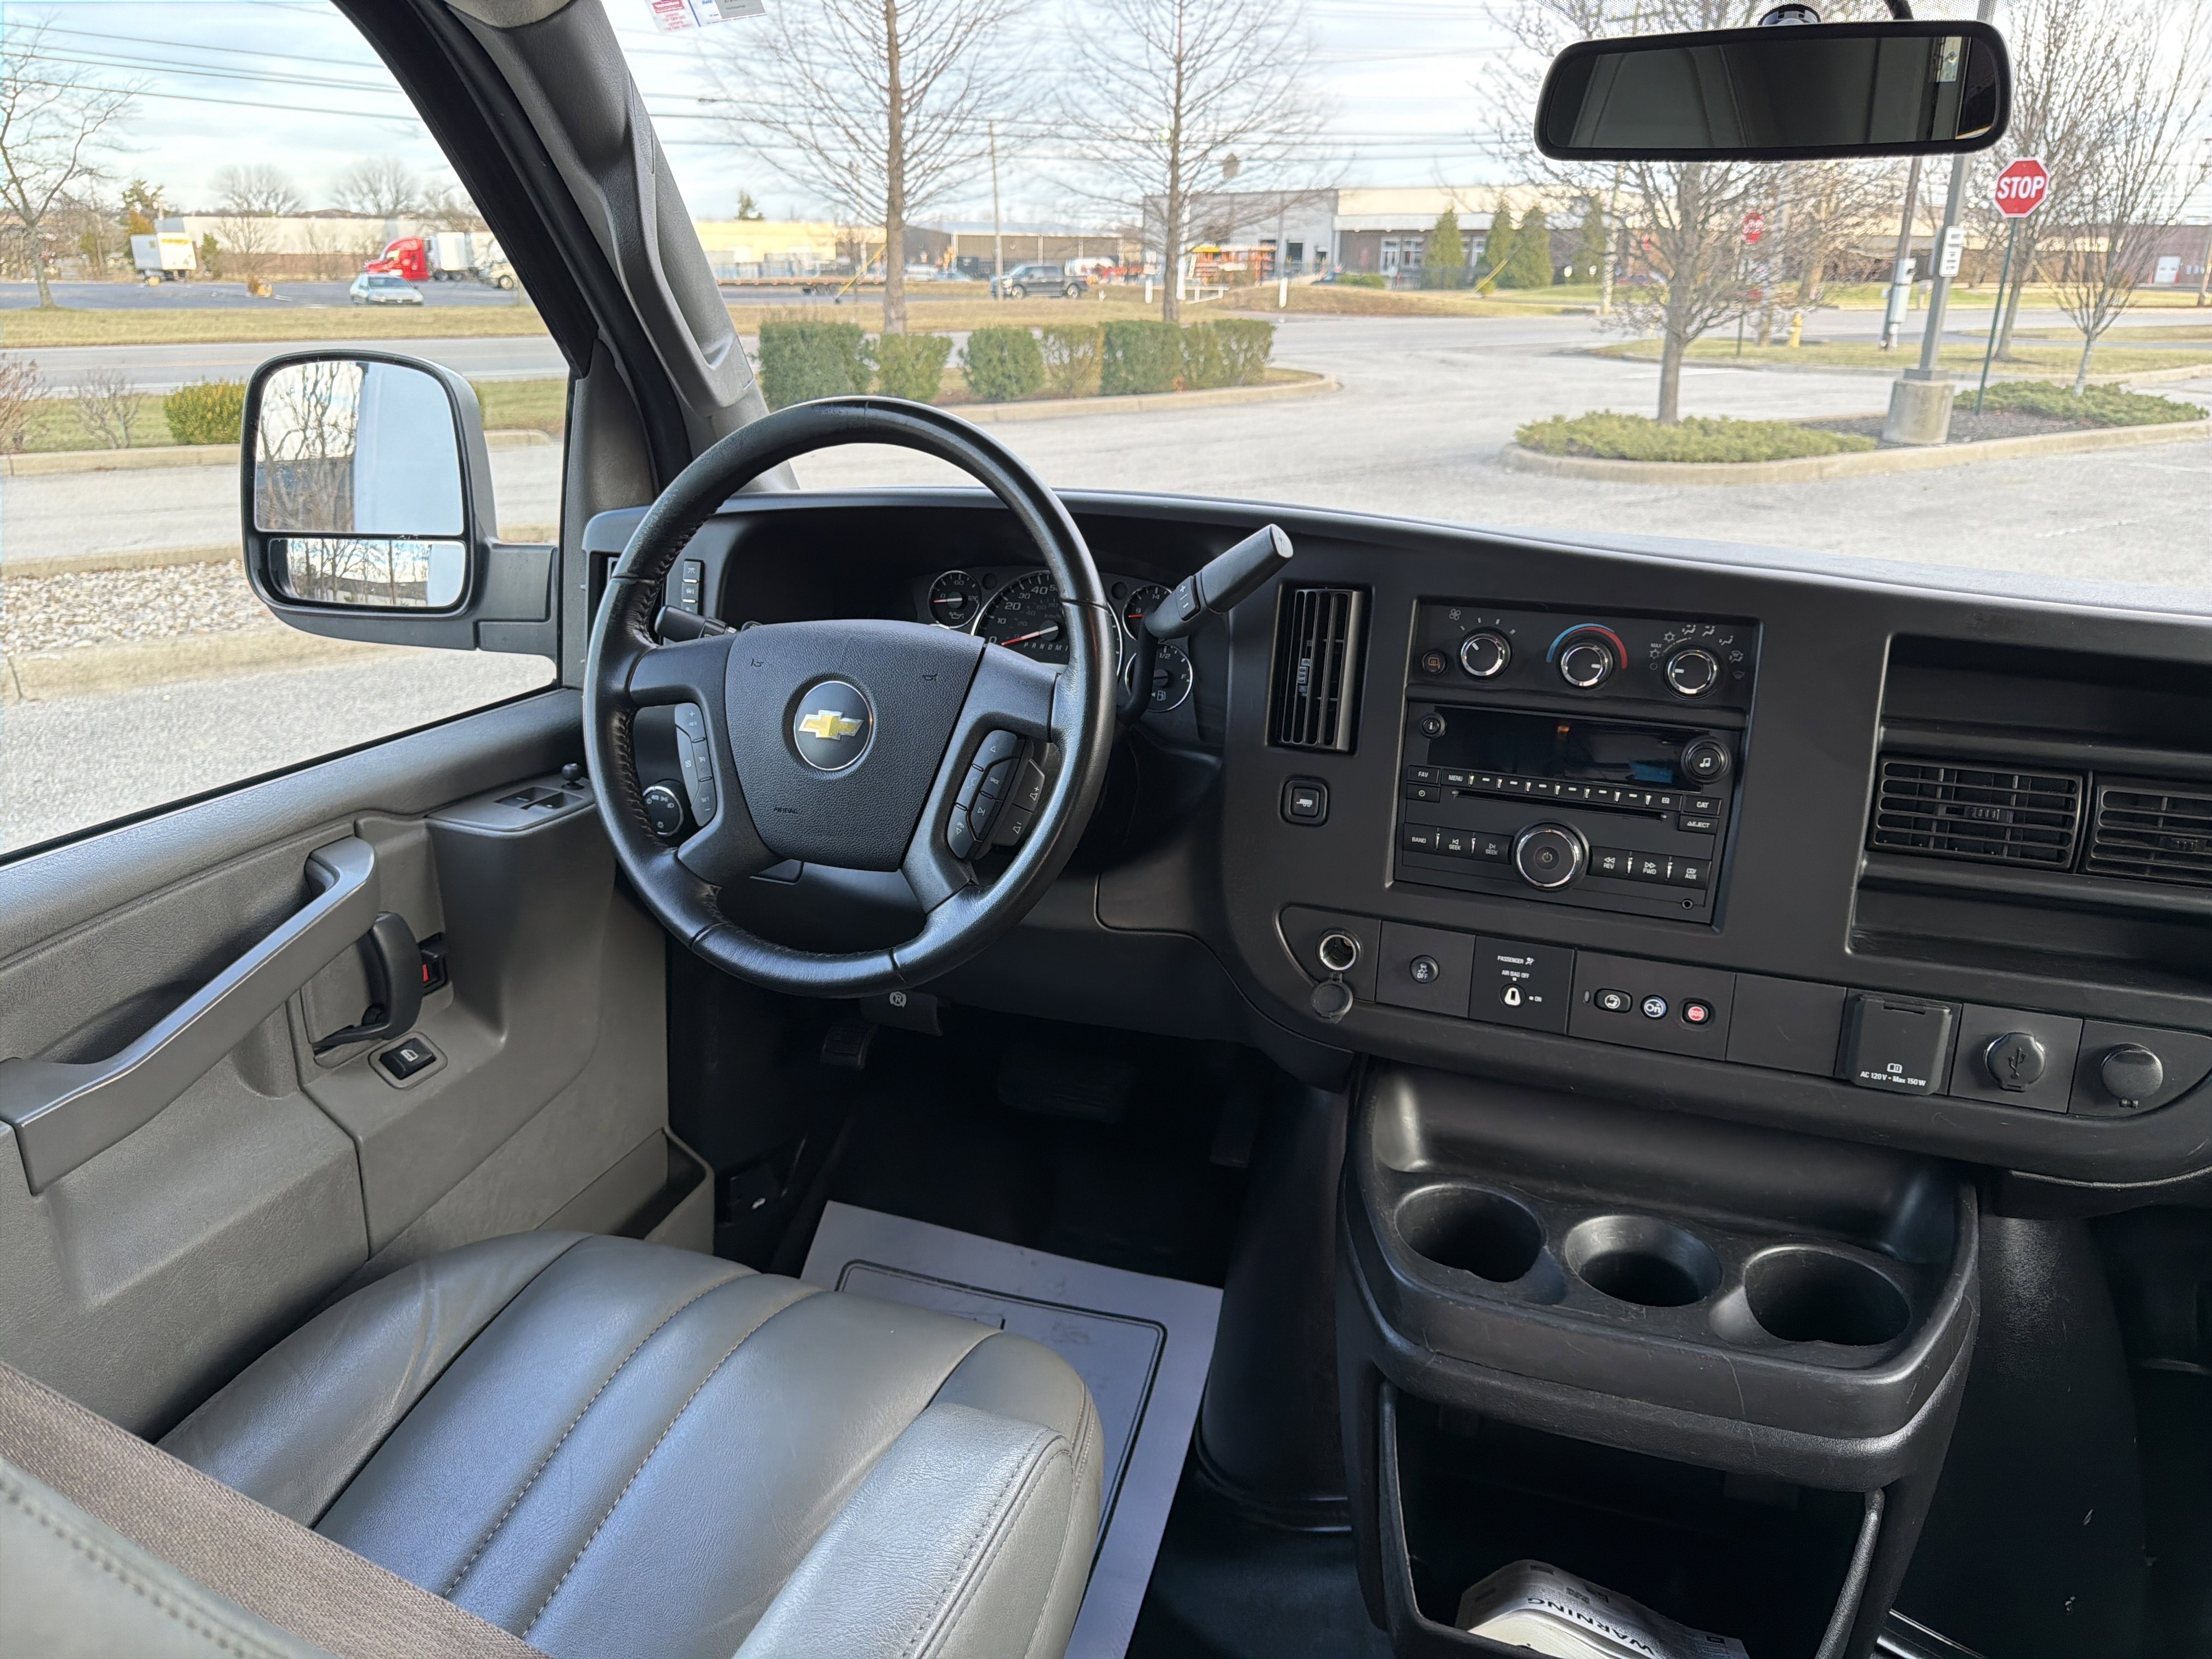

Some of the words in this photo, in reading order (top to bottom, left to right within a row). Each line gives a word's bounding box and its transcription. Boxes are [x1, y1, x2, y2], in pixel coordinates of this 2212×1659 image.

[1997, 176, 2045, 199] STOP
[1031, 586, 1048, 595] 40
[1005, 602, 1022, 611] 20
[1497, 955, 1524, 964] PASSENGER
[1528, 1598, 1655, 1655] WARNING
